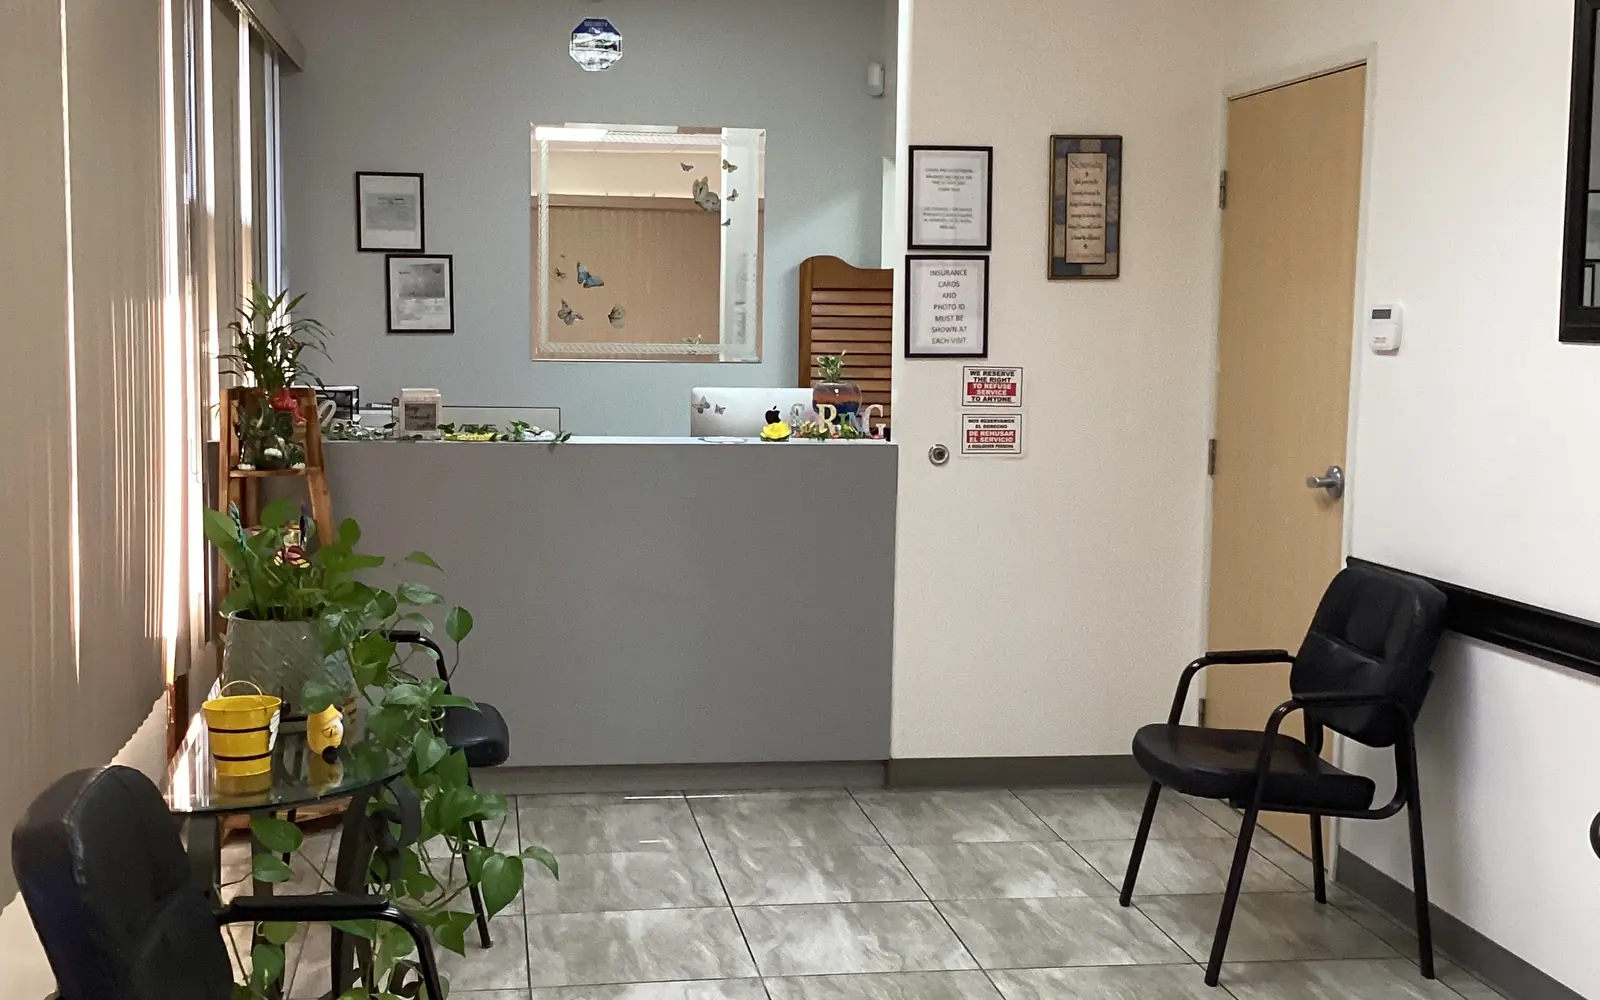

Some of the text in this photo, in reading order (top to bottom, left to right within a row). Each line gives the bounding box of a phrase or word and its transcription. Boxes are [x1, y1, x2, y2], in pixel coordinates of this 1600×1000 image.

[929, 268, 968, 277] INSURANCE
[938, 280, 960, 288] CARDS
[933, 303, 966, 311] PHOTO ID
[955, 314, 964, 322] BE
[931, 325, 967, 334] SHOWN AT
[931, 337, 967, 345] EACH VISIT
